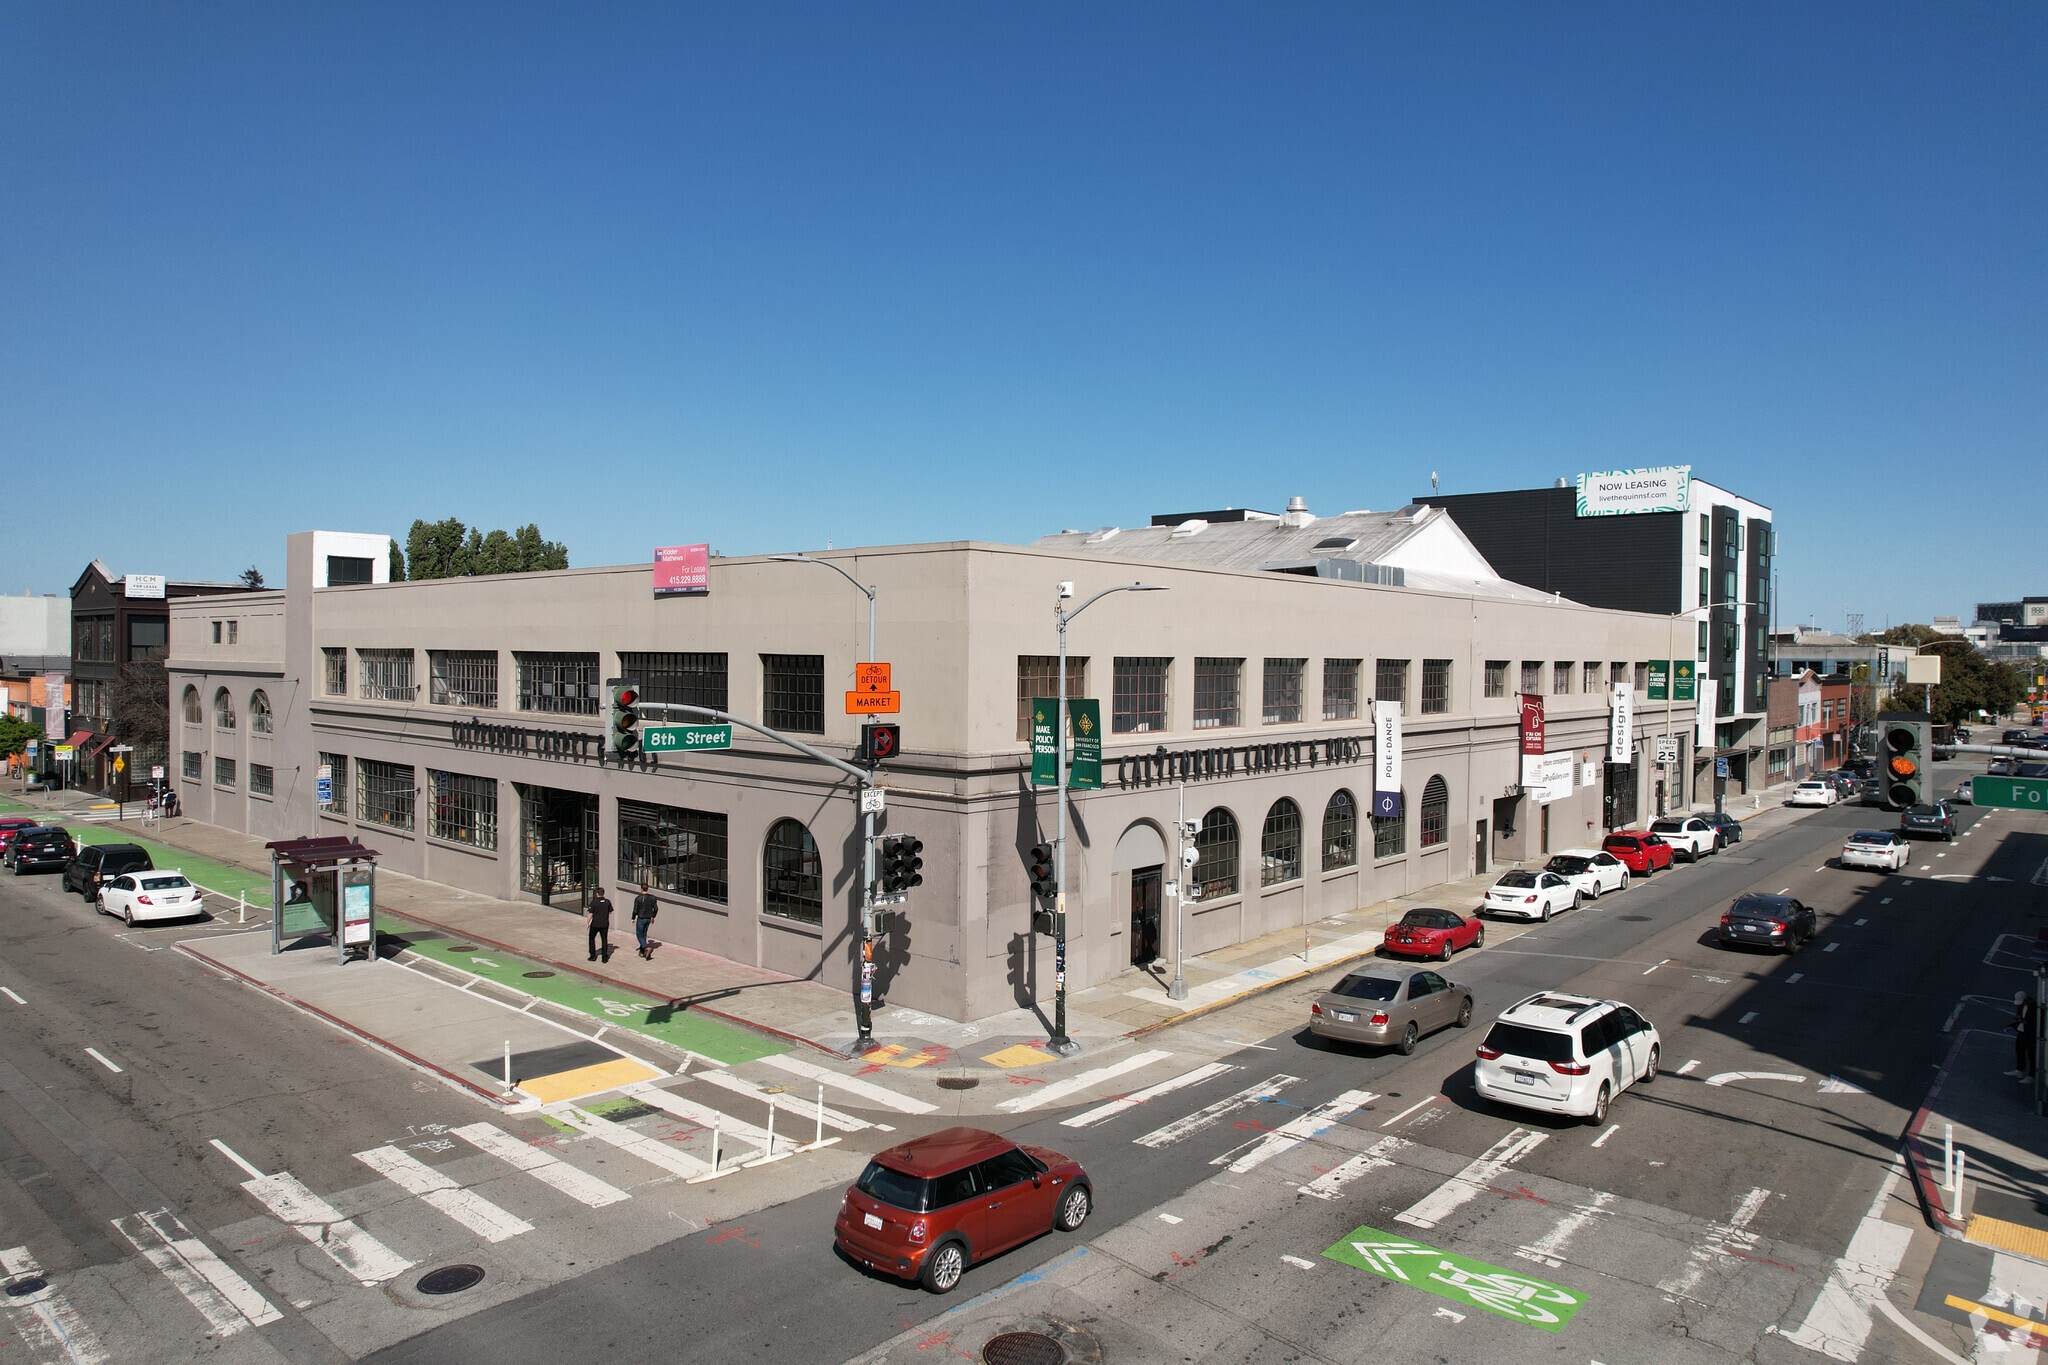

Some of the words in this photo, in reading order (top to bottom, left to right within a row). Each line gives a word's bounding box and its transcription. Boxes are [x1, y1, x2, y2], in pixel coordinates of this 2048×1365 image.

[1599, 483, 1623, 491] NOW
[1625, 479, 1667, 490] LEASING
[1599, 492, 1667, 502] livethequinnsf.com
[681, 565, 690, 574] For
[691, 565, 706, 573] Lease
[861, 676, 888, 684] DETOUR
[856, 697, 891, 707] MARKET
[1035, 725, 1051, 734] MAKE
[1616, 705, 1626, 755] design
[650, 732, 676, 746] 8th
[685, 730, 726, 745] Street
[1035, 735, 1054, 744] POLICY
[1658, 751, 1676, 761] 25
[1118, 745, 1234, 791] CALIFORNIA
[1245, 741, 1301, 776] CARPET
[863, 790, 883, 798] EXCEPT
